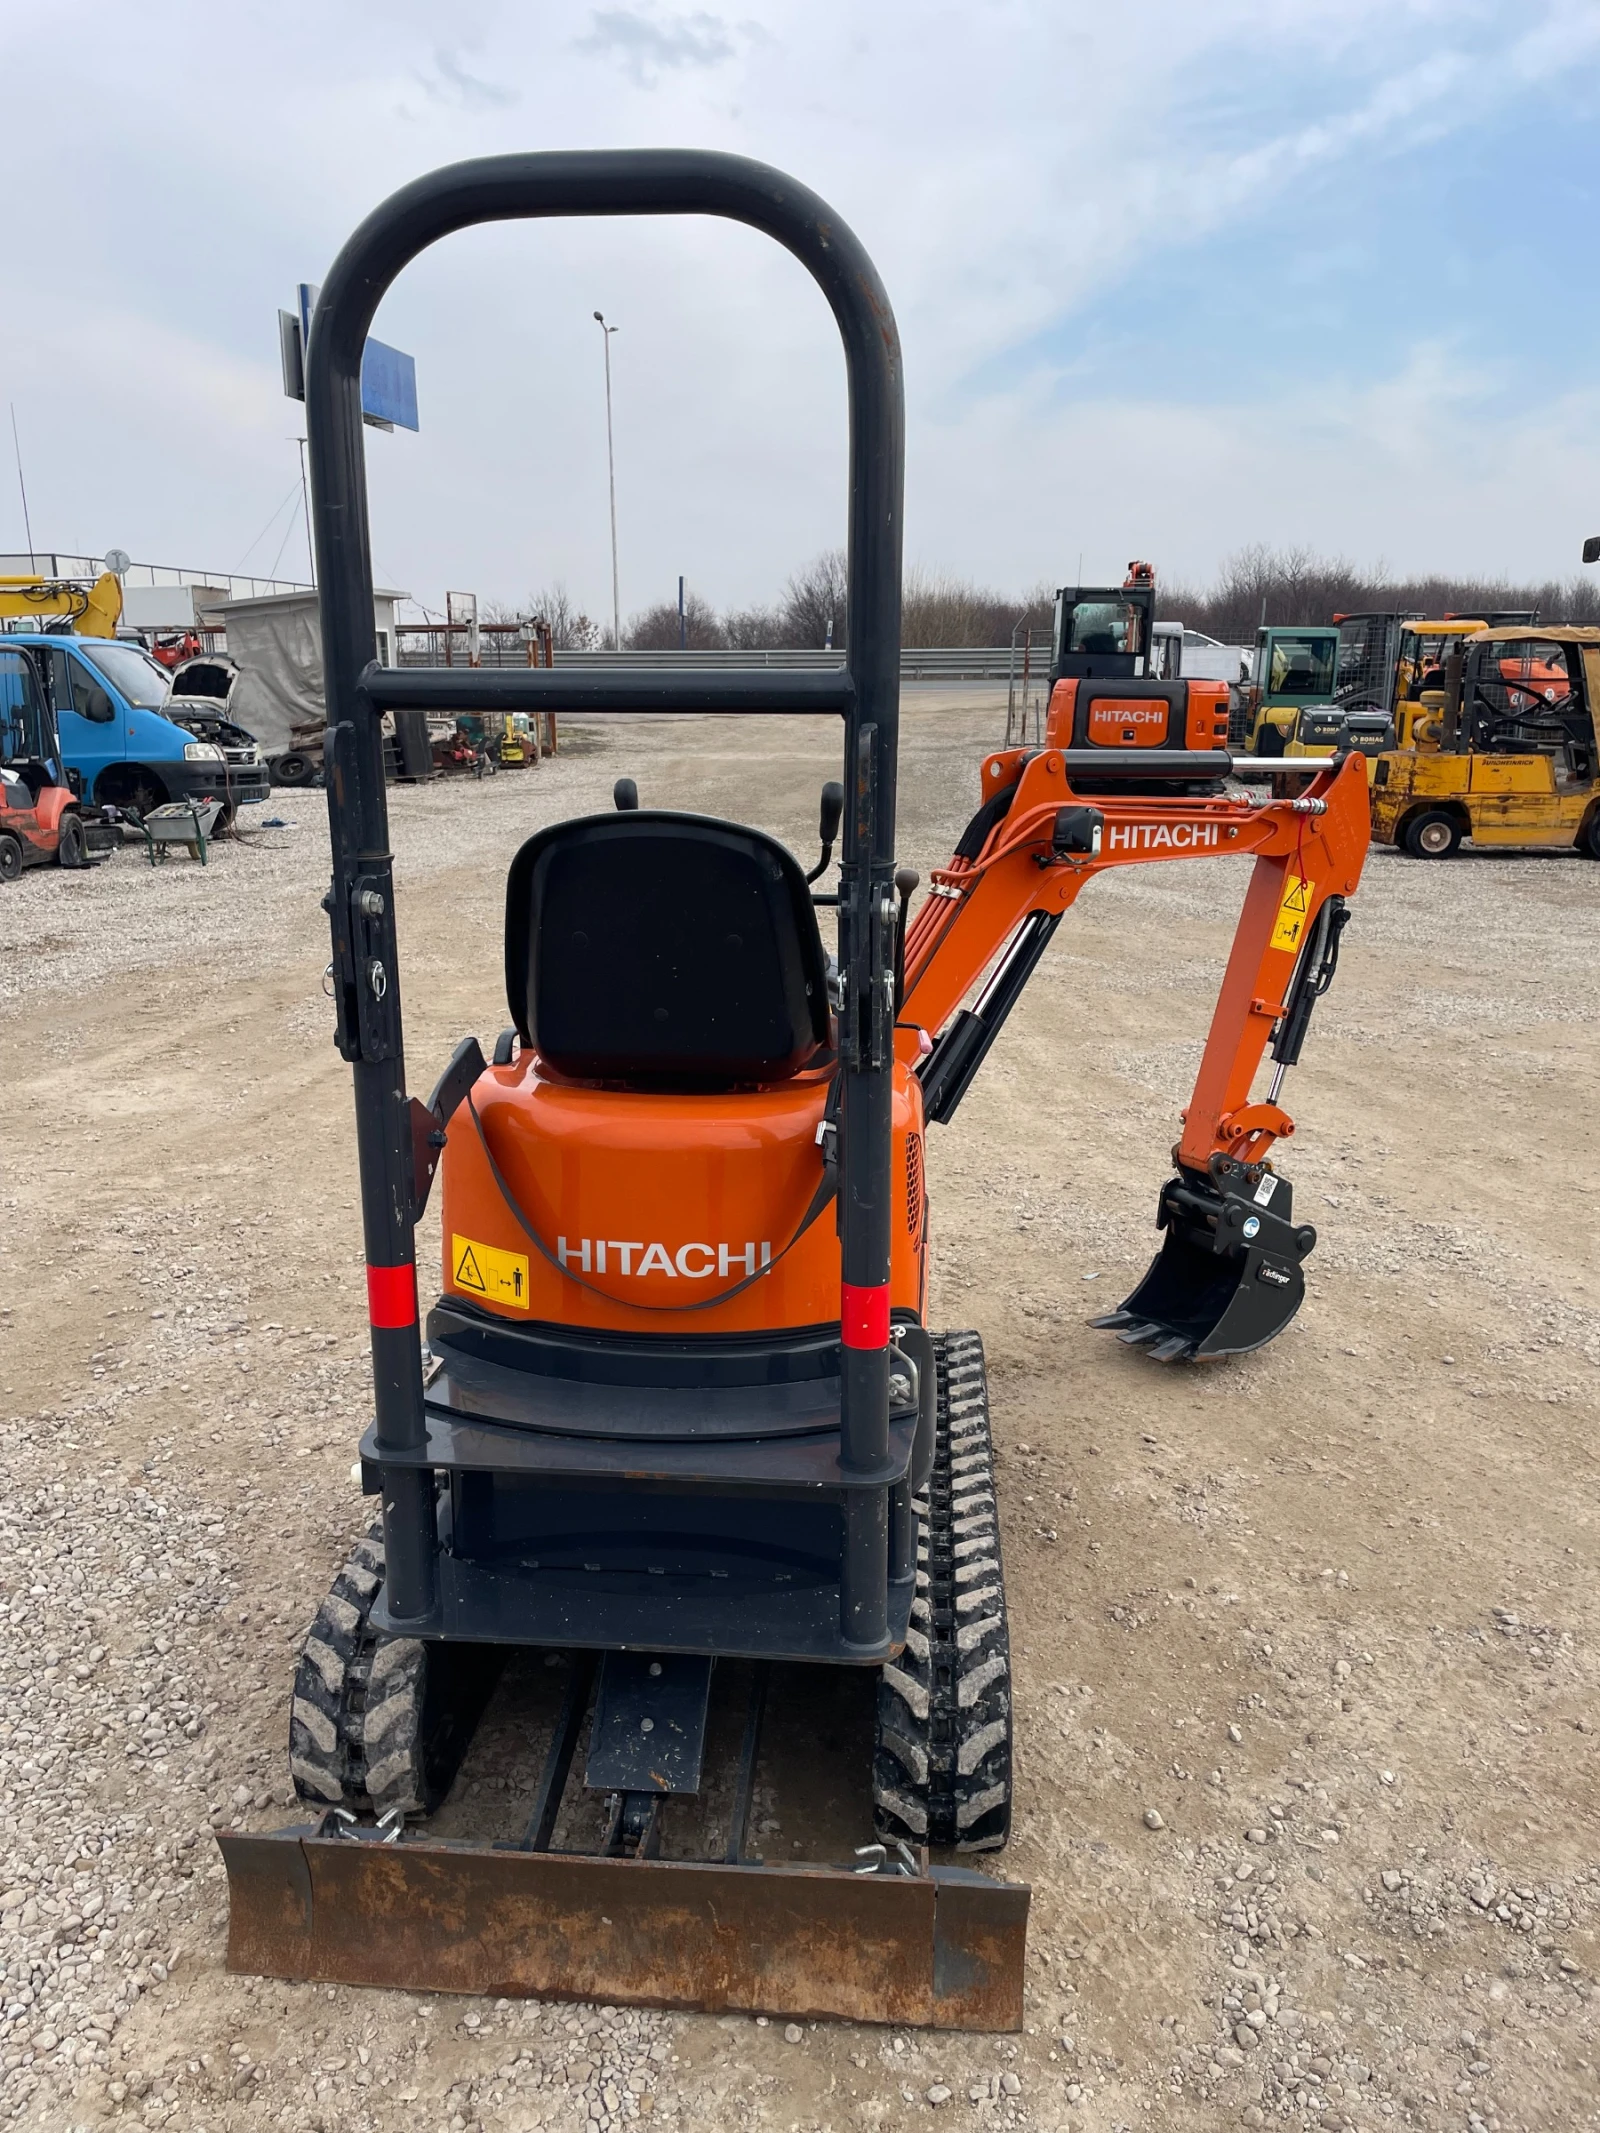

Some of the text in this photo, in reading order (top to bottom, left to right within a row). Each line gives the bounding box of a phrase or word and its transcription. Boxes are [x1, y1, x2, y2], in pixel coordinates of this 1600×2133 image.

[1094, 710, 1163, 723] HITACHI
[1110, 823, 1219, 849] HITACHI
[557, 1235, 772, 1278] HITACHI
